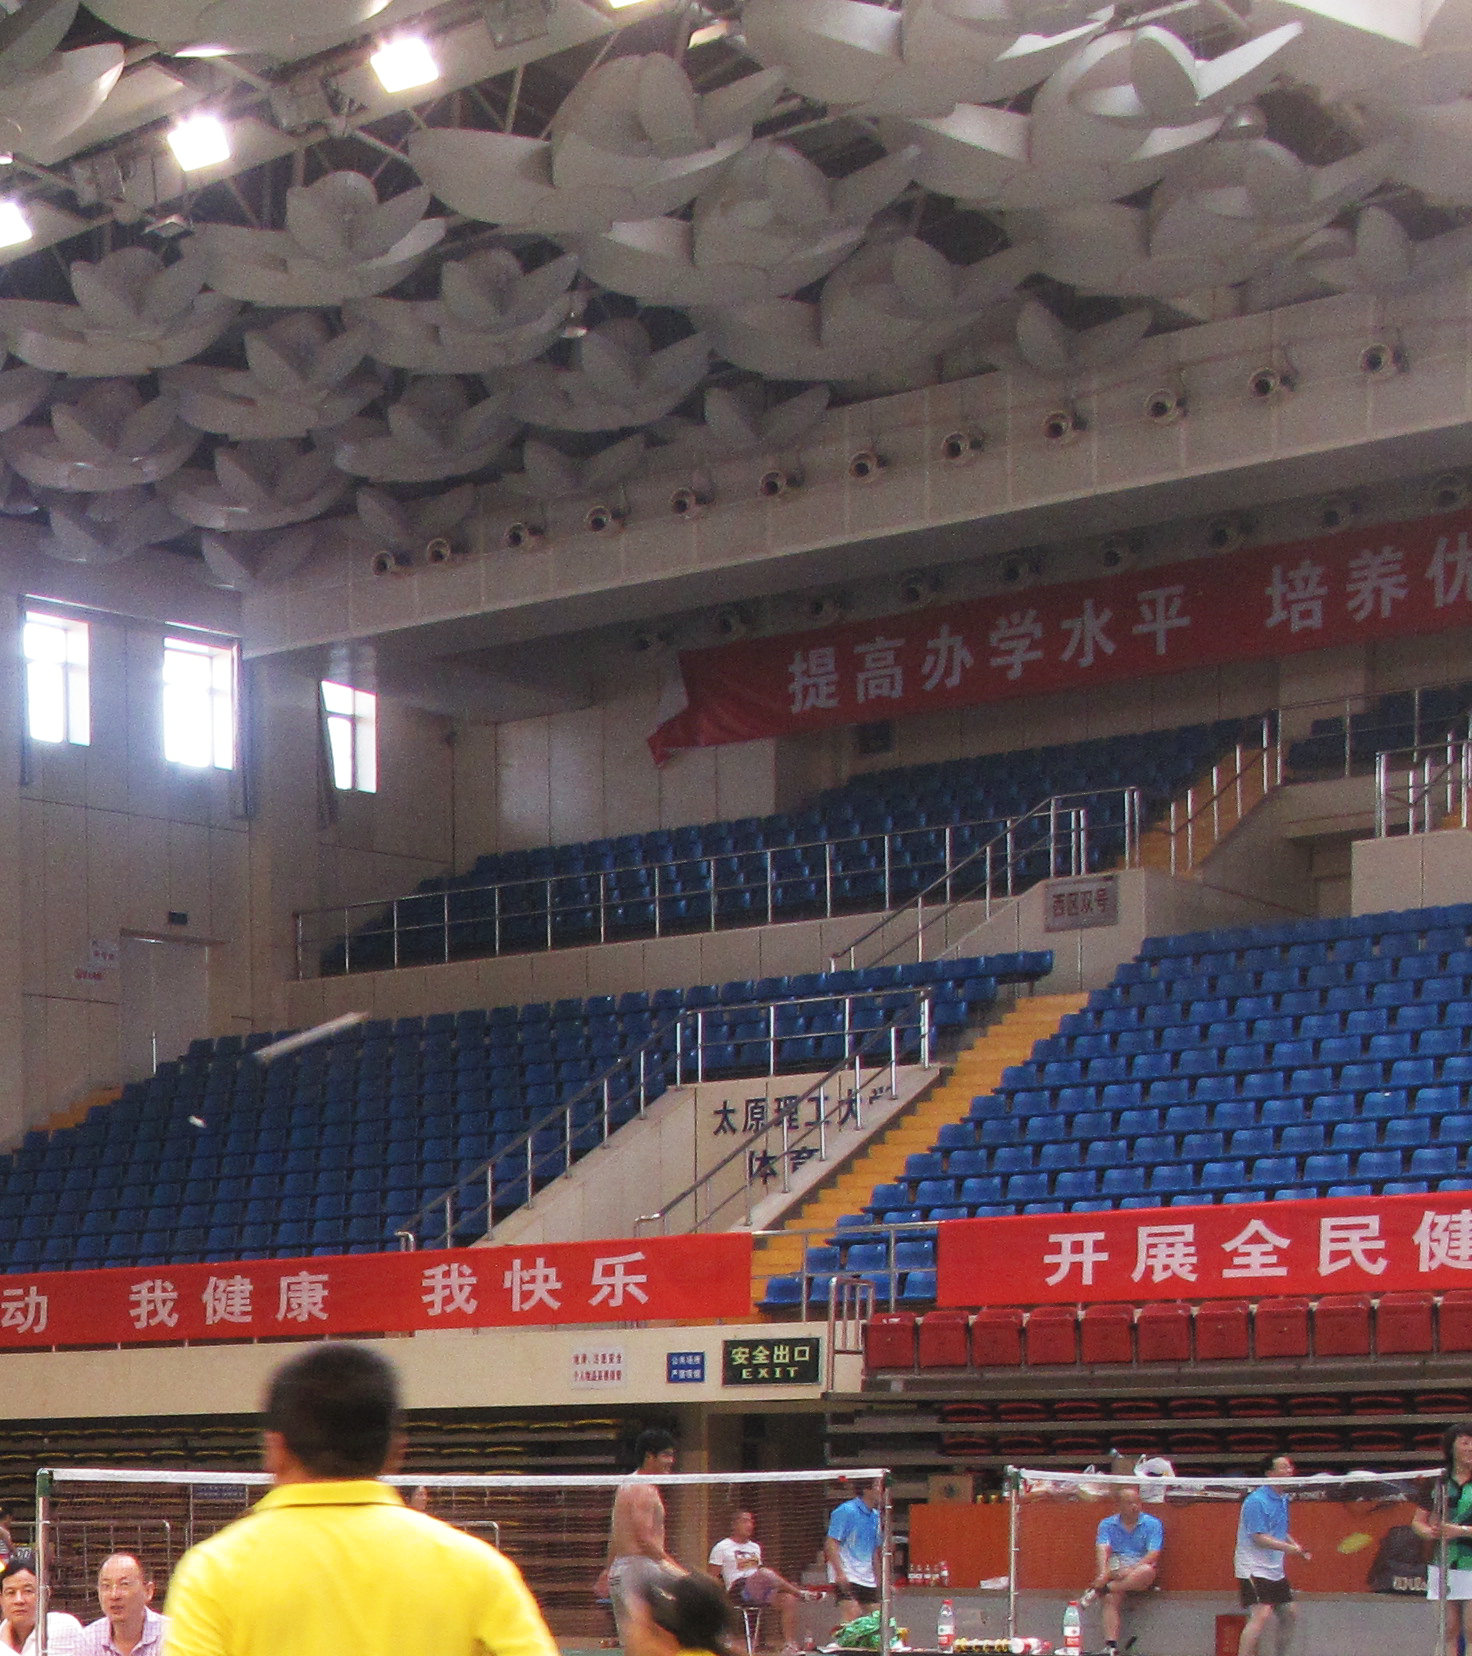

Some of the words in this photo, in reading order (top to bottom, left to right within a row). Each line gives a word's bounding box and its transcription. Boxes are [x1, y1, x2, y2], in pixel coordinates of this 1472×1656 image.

[787, 584, 1192, 714] 提高办学水平
[712, 1084, 894, 1136] 太原理工大
[1043, 1209, 1472, 1288] 开展全民健
[128, 1270, 330, 1330] 我健康
[421, 1251, 649, 1316] 我快乐
[732, 1344, 810, 1366] 安全出口
[741, 1366, 799, 1380] EXIT
